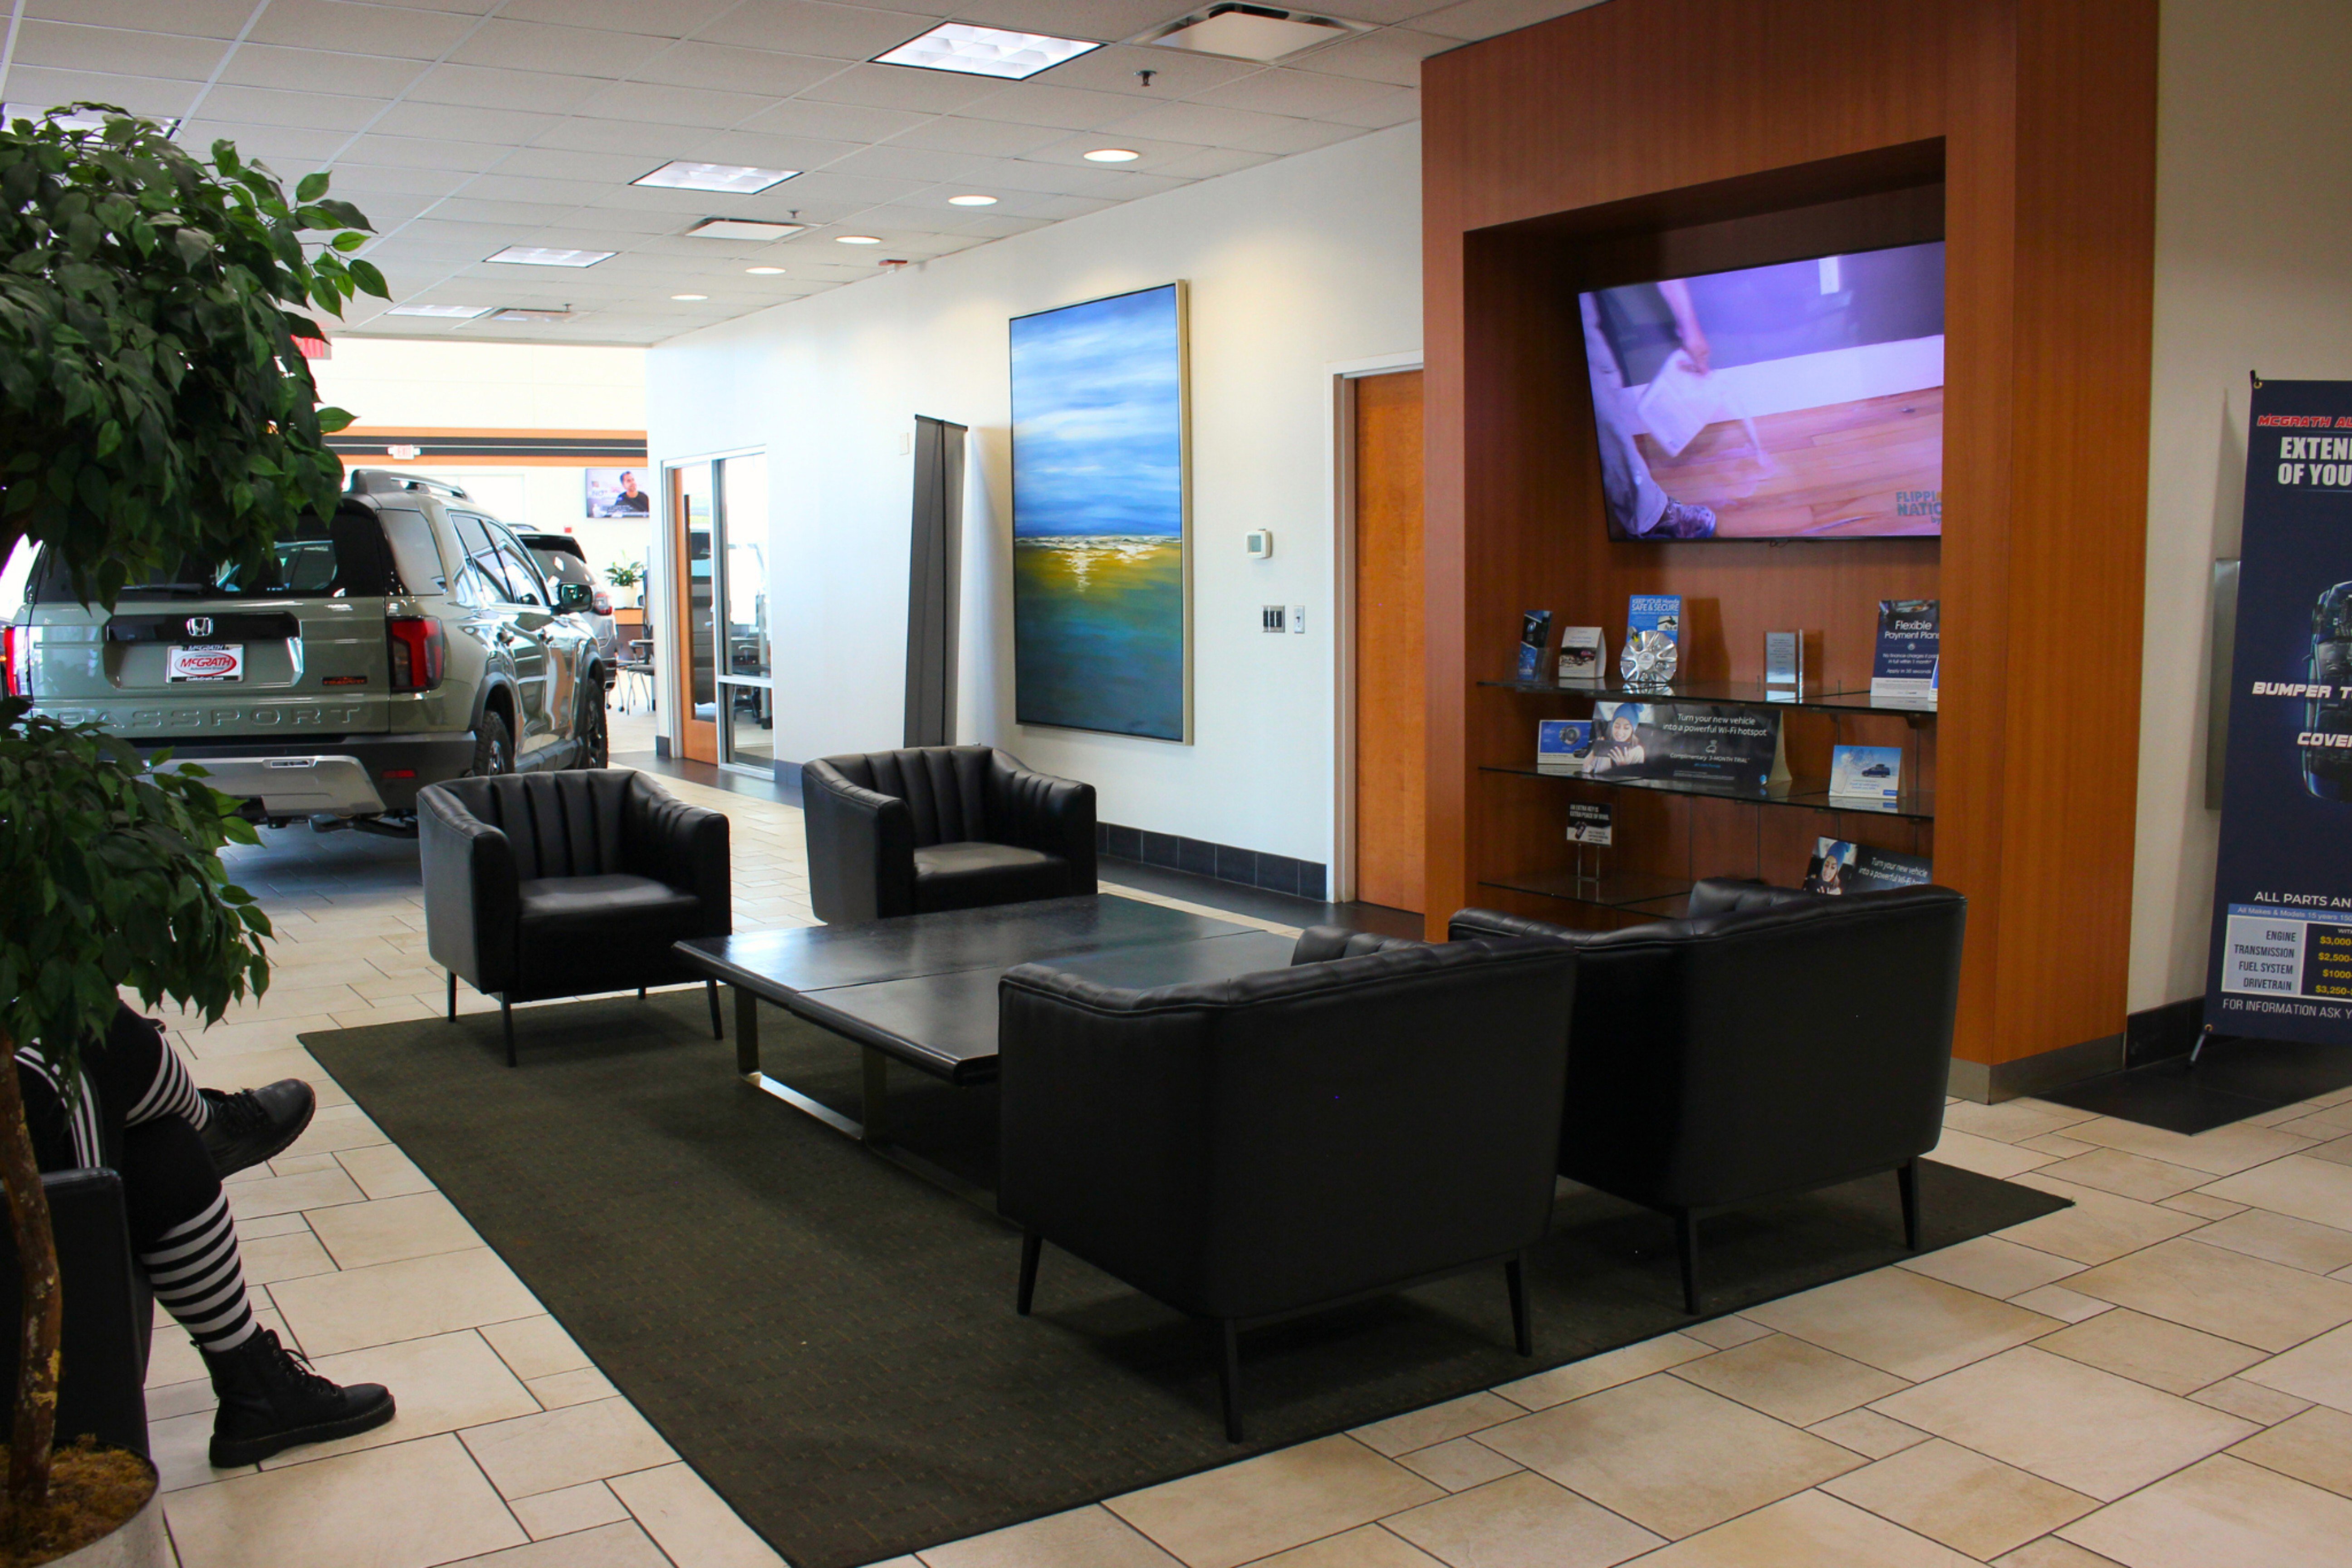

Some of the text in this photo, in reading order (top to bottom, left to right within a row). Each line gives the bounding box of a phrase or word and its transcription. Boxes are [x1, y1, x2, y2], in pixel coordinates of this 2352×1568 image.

[2280, 436, 2352, 460] EXTEN
[2278, 463, 2304, 485] OF
[1895, 620, 1932, 630] Flexible
[1885, 631, 1919, 640] Payment
[2252, 682, 2352, 699] BUMPER T
[1678, 713, 1694, 721] Turn
[1695, 715, 1712, 724] your
[1730, 716, 1755, 725] vehicle
[1684, 725, 1717, 733] powerful
[1737, 727, 1767, 737] hotspot
[1670, 752, 1707, 761] Complimentary
[1859, 866, 1869, 876] into
[1874, 872, 1898, 882] powerful
[1872, 857, 1883, 866] Turn
[1909, 867, 1928, 877] vehicle
[2254, 891, 2279, 902] ALL
[2283, 893, 2327, 906] PARTS
[2266, 930, 2297, 942] ENGINE
[2234, 944, 2295, 958] TRANSMISSION
[2239, 961, 2293, 975] FUEL SYSTEM
[2243, 977, 2291, 990] DRIVETRAIN
[2223, 999, 2243, 1010] FOR
[2246, 1000, 2317, 1016] INFORMATION
[2319, 1007, 2341, 1019] ASK
